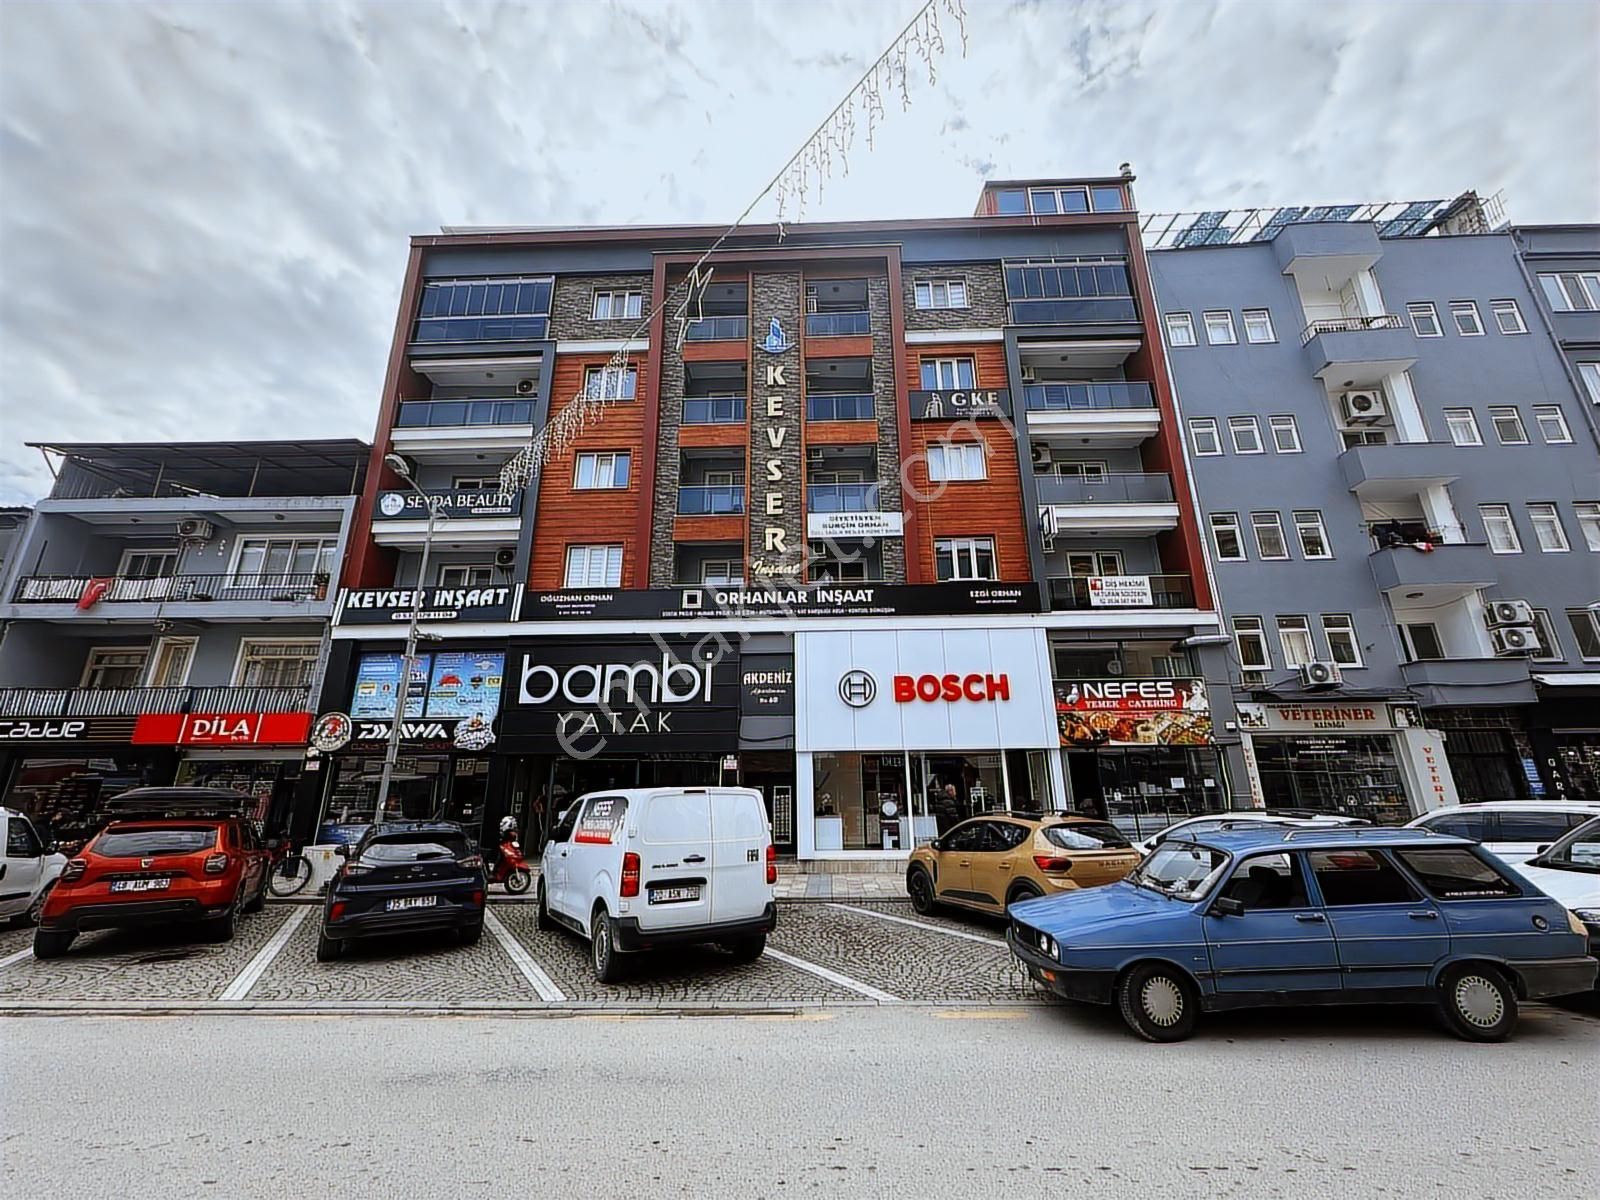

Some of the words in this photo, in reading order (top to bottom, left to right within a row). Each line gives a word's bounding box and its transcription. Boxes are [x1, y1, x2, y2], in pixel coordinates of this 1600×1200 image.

[765, 364, 788, 553] KEVSER
[346, 590, 426, 609] KEVSER
[433, 588, 510, 610] İNŞAAT
[715, 589, 808, 606] ORHANLAR
[816, 586, 874, 606] İNŞAAT
[518, 652, 713, 705] bambi
[743, 669, 793, 686] AKDENİZ
[893, 673, 1011, 703] BOSCH
[1082, 681, 1175, 699] NEFES
[1085, 700, 1120, 709] YEMEK
[1278, 705, 1377, 722] VETERİNER
[191, 716, 251, 736] DİLA
[556, 711, 672, 734] YATAK
